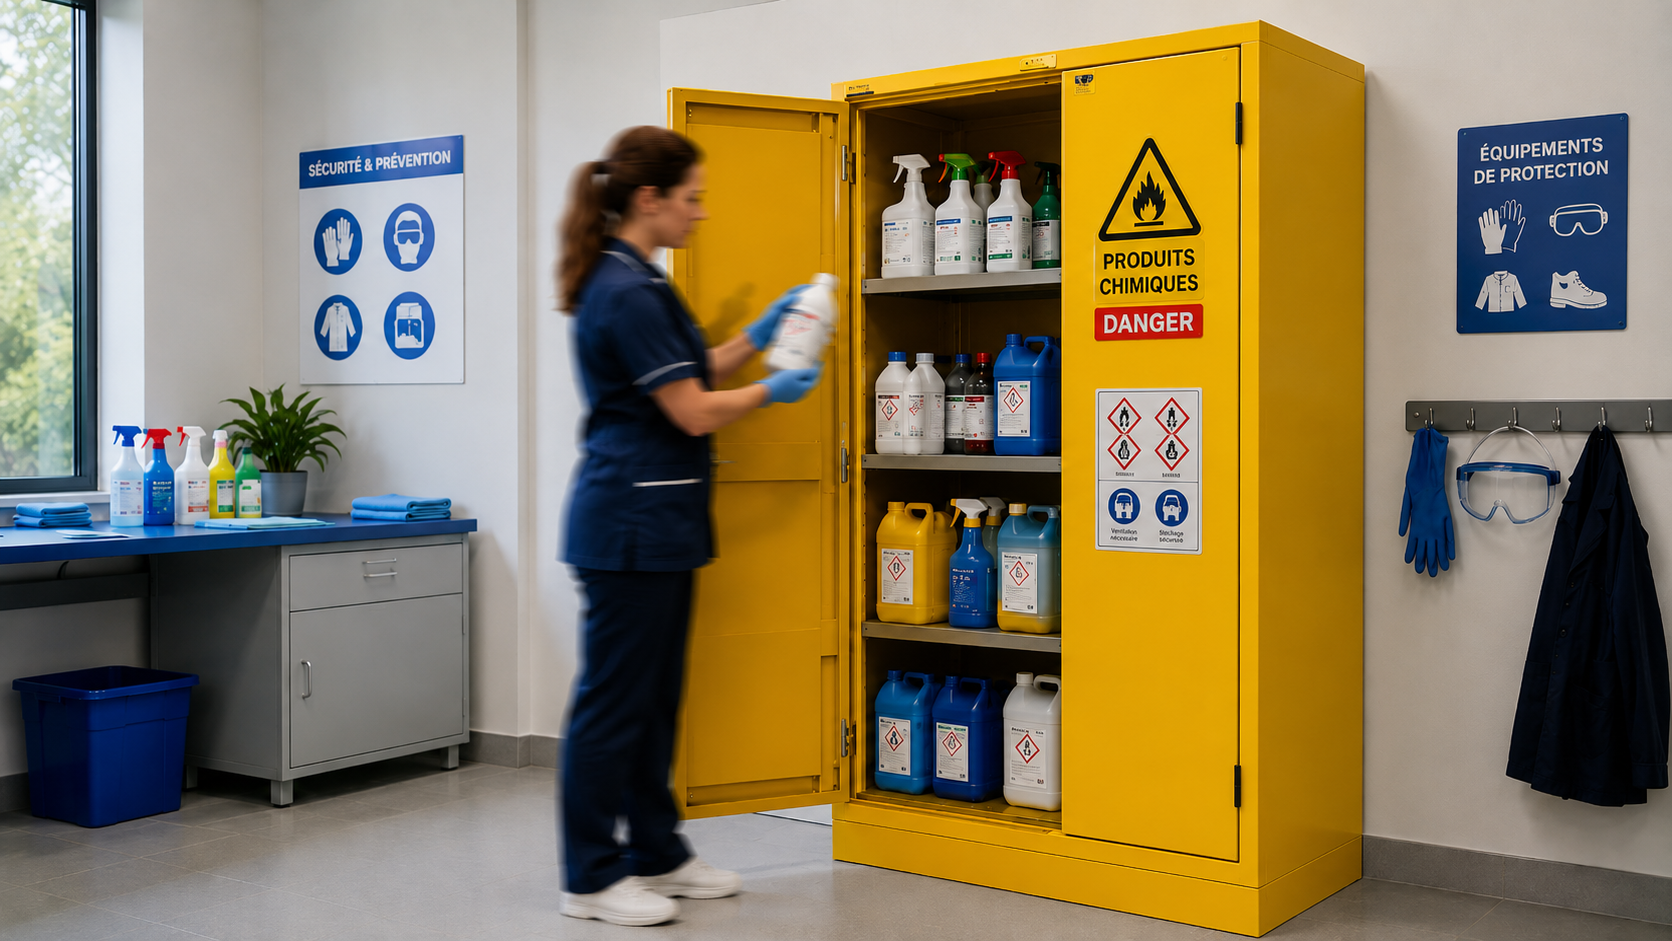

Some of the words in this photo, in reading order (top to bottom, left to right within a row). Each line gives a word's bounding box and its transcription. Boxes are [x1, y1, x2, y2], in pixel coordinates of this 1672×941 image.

[1480, 137, 1604, 162] ÉQUIPEMENTS
[309, 156, 362, 177] SÉCURITÉ
[364, 158, 373, 172] &
[375, 150, 451, 171] PRÉVENTION
[1474, 169, 1496, 185] DE
[1500, 160, 1609, 183] PROTECTION
[1103, 248, 1195, 270] PRODUITS
[1099, 274, 1198, 295] CHIMIQUES
[1103, 311, 1194, 334] DANGER
